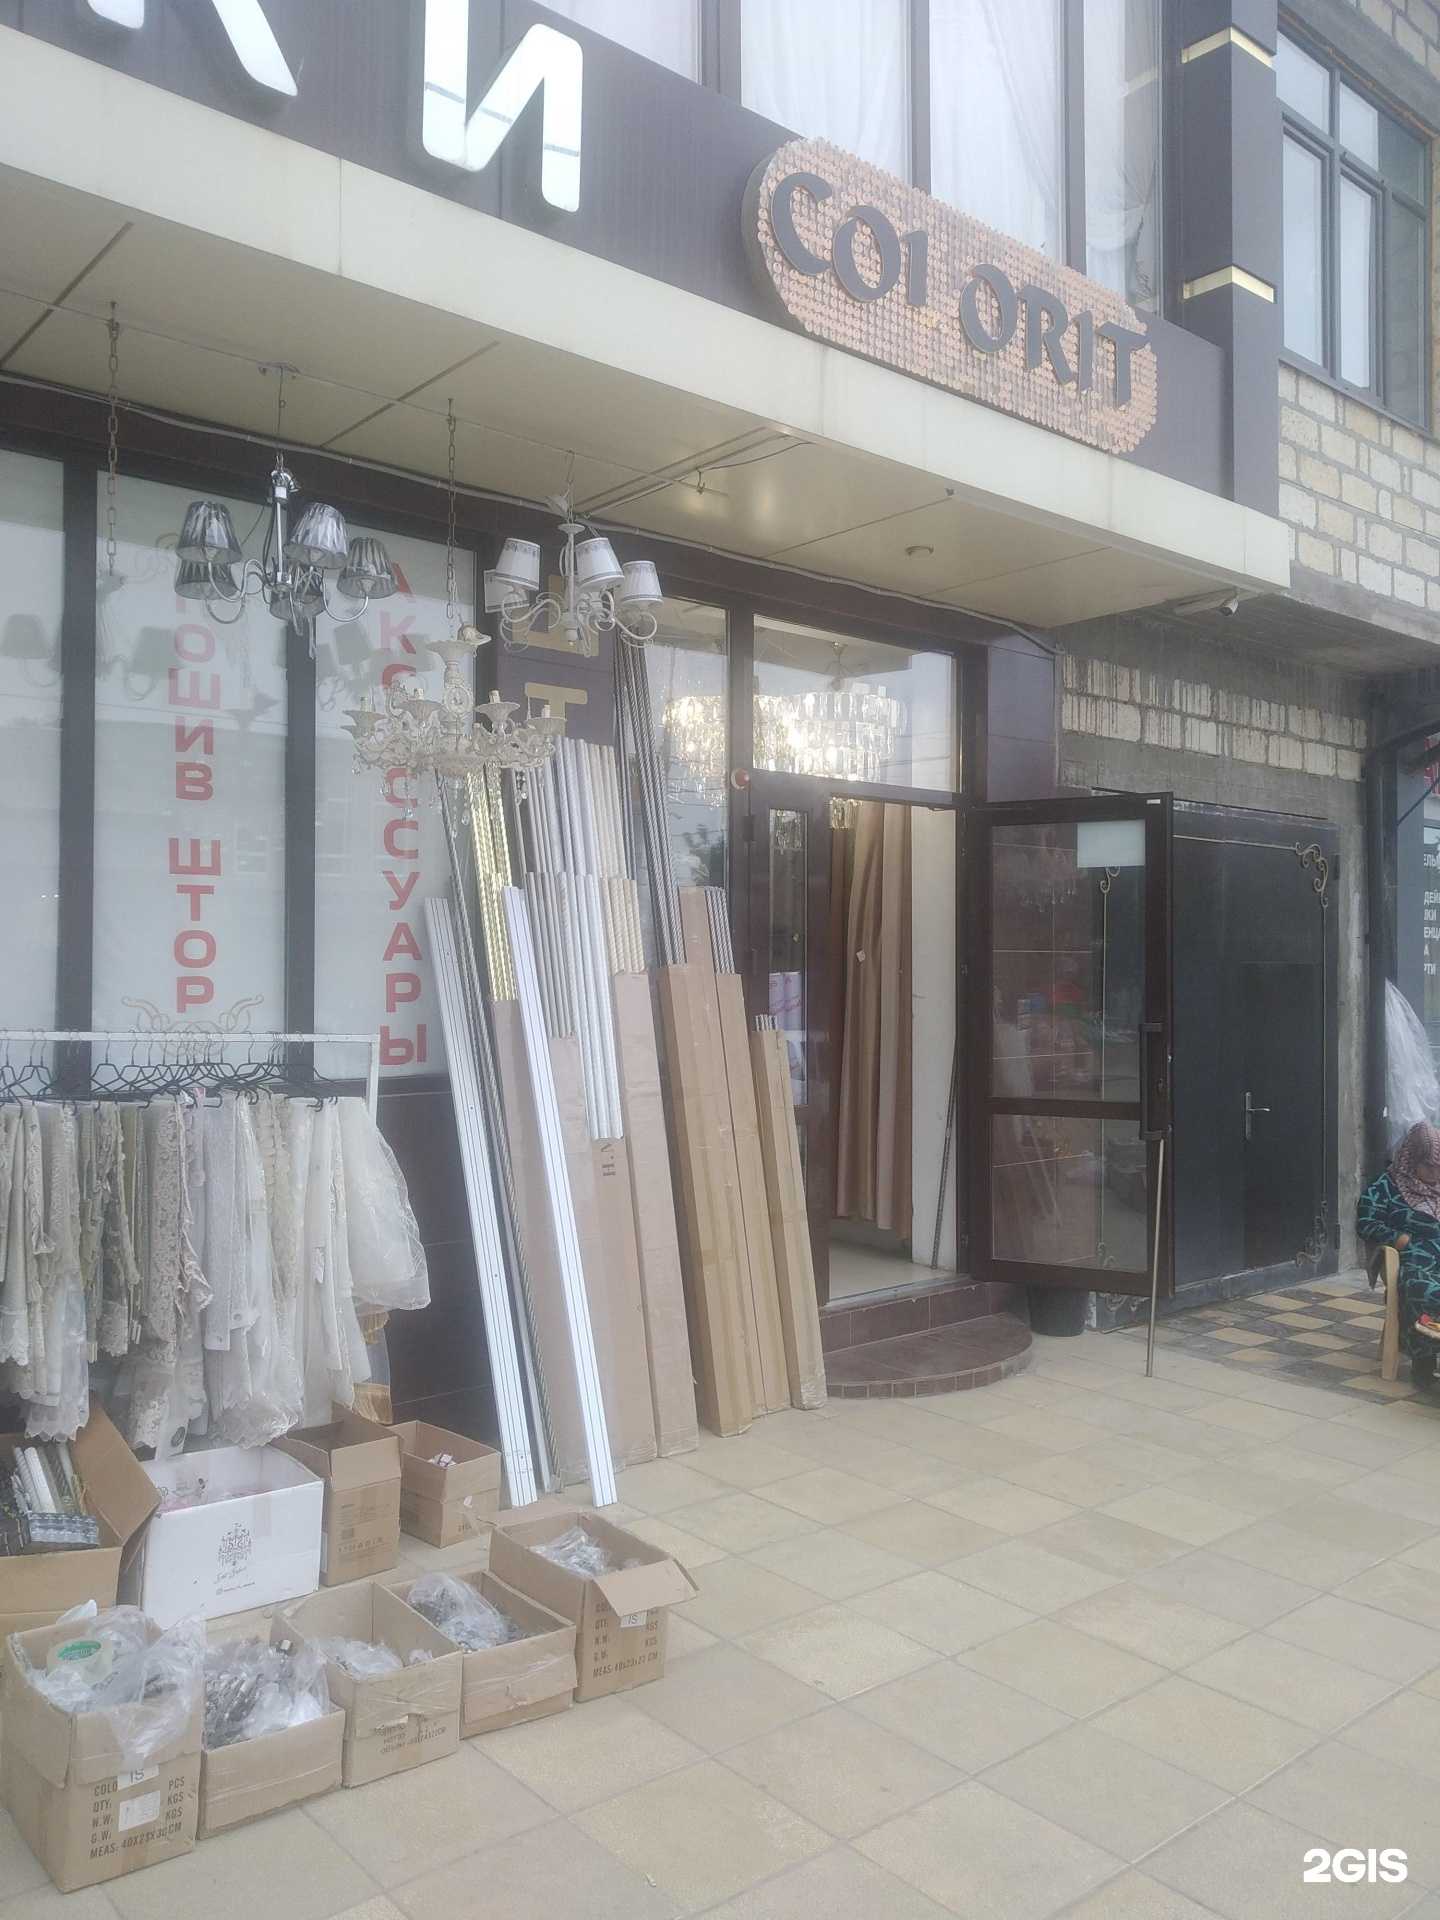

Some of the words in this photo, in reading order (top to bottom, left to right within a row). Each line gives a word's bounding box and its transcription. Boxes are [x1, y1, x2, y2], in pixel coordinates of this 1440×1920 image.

[167, 588, 221, 802] ОШИВ
[378, 562, 429, 1067] КССУАРЫ
[167, 836, 222, 1014] ШТОР
